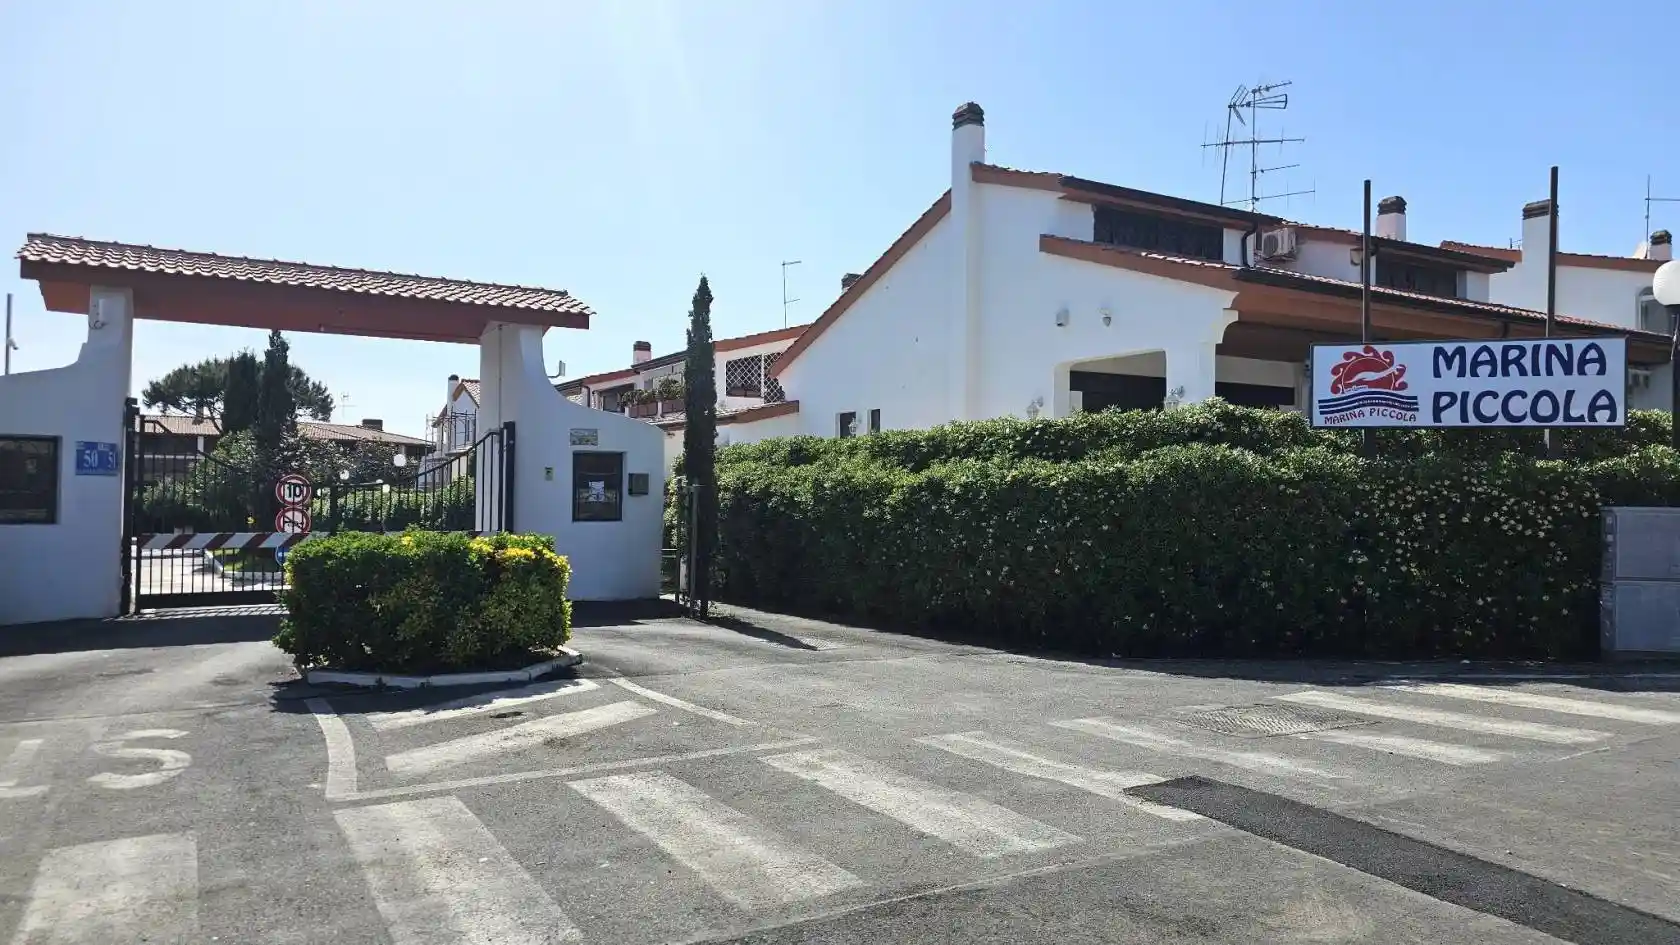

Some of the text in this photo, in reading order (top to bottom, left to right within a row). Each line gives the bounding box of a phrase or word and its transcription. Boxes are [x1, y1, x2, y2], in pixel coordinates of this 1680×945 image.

[1432, 342, 1607, 379] MARINA
[1324, 407, 1417, 425] MARINA PICCOLA
[1432, 389, 1618, 424] PICCOLA
[82, 449, 99, 468] 50
[286, 483, 303, 498] 10
